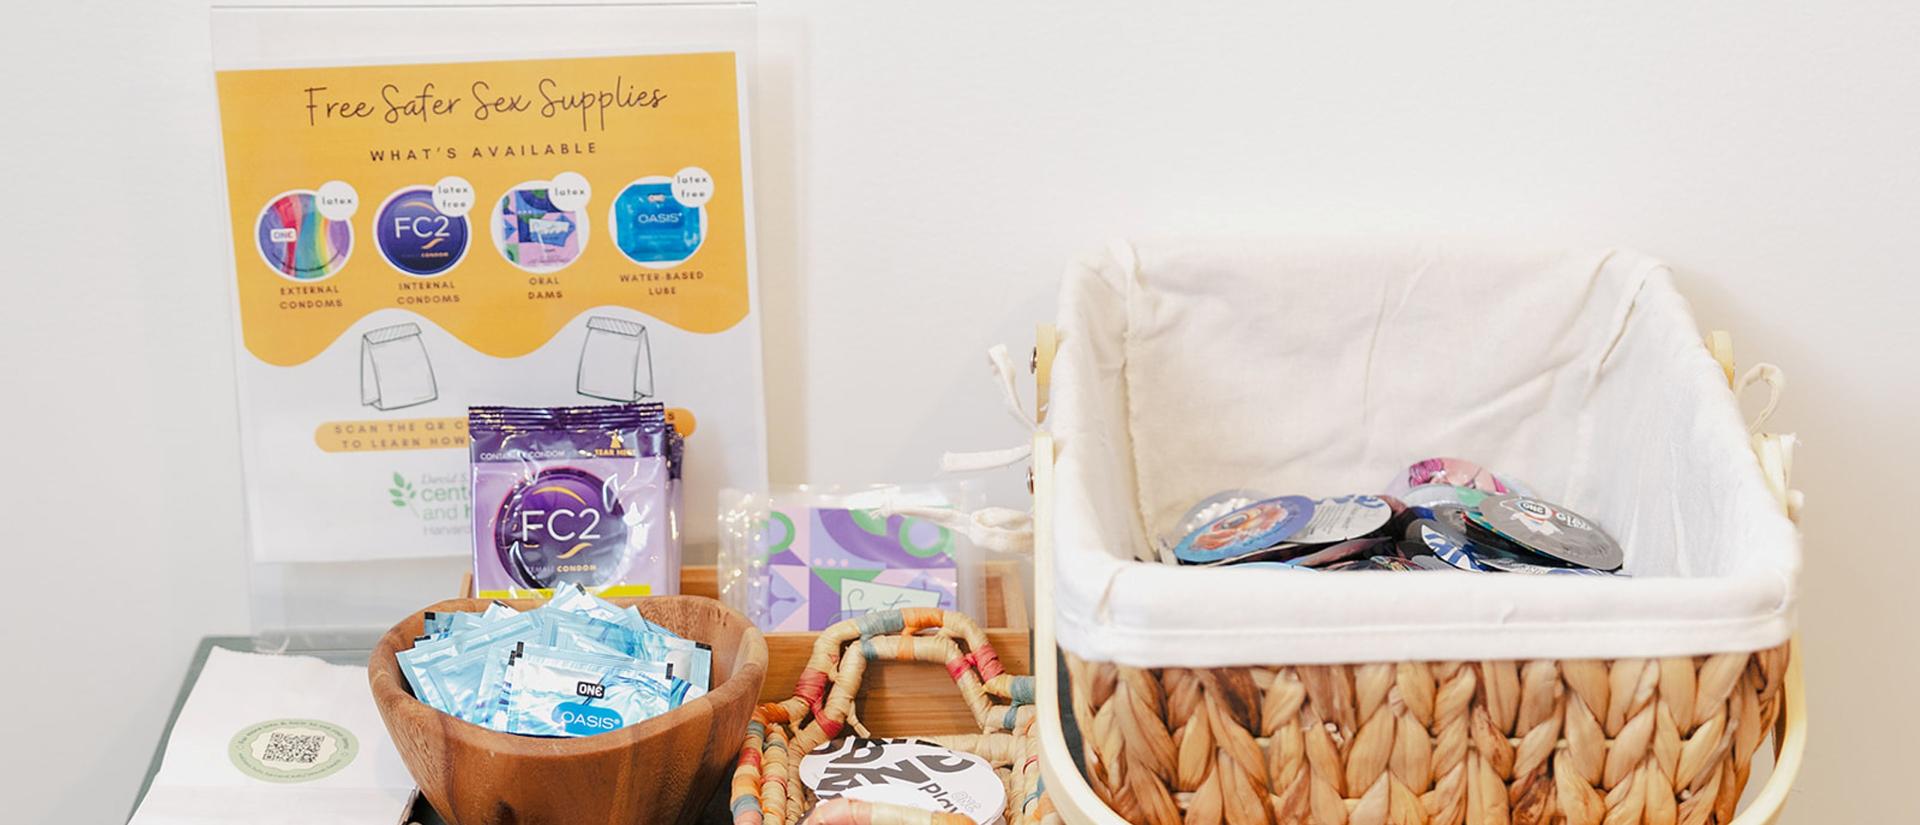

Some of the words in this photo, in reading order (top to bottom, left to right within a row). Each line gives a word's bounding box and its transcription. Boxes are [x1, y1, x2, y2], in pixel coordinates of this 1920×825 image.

[304, 86, 374, 126] Free
[381, 82, 461, 123] Safer
[471, 80, 532, 121] Sex
[538, 76, 669, 132] Supplies
[370, 147, 457, 162] WHAT'S
[472, 142, 597, 158] AVAILABLE
[676, 175, 708, 184] latex
[437, 186, 469, 194] latex
[554, 188, 585, 197] latex
[681, 190, 706, 198] free
[321, 196, 353, 205] latex
[442, 200, 467, 208] free
[394, 216, 451, 239] FC2
[529, 276, 560, 286] ORAL
[619, 270, 705, 283] WATER-BASED
[280, 285, 340, 296] EXTERNAL
[398, 281, 456, 291] INTERNAL
[648, 287, 677, 296] LUBE
[397, 294, 461, 305] CONDOMS
[528, 291, 563, 300] DAMS
[279, 299, 343, 310] CONDOMS
[335, 424, 379, 434] SCAN
[387, 422, 416, 432] THE
[425, 421, 445, 431] QR
[342, 439, 362, 449] TO
[371, 438, 421, 448] LEARN
[429, 436, 466, 446] HOW
[421, 486, 470, 502] cent
[423, 505, 458, 521] and
[521, 508, 601, 541] FC2
[556, 564, 597, 573] CONDOM
[579, 684, 603, 697] ONE
